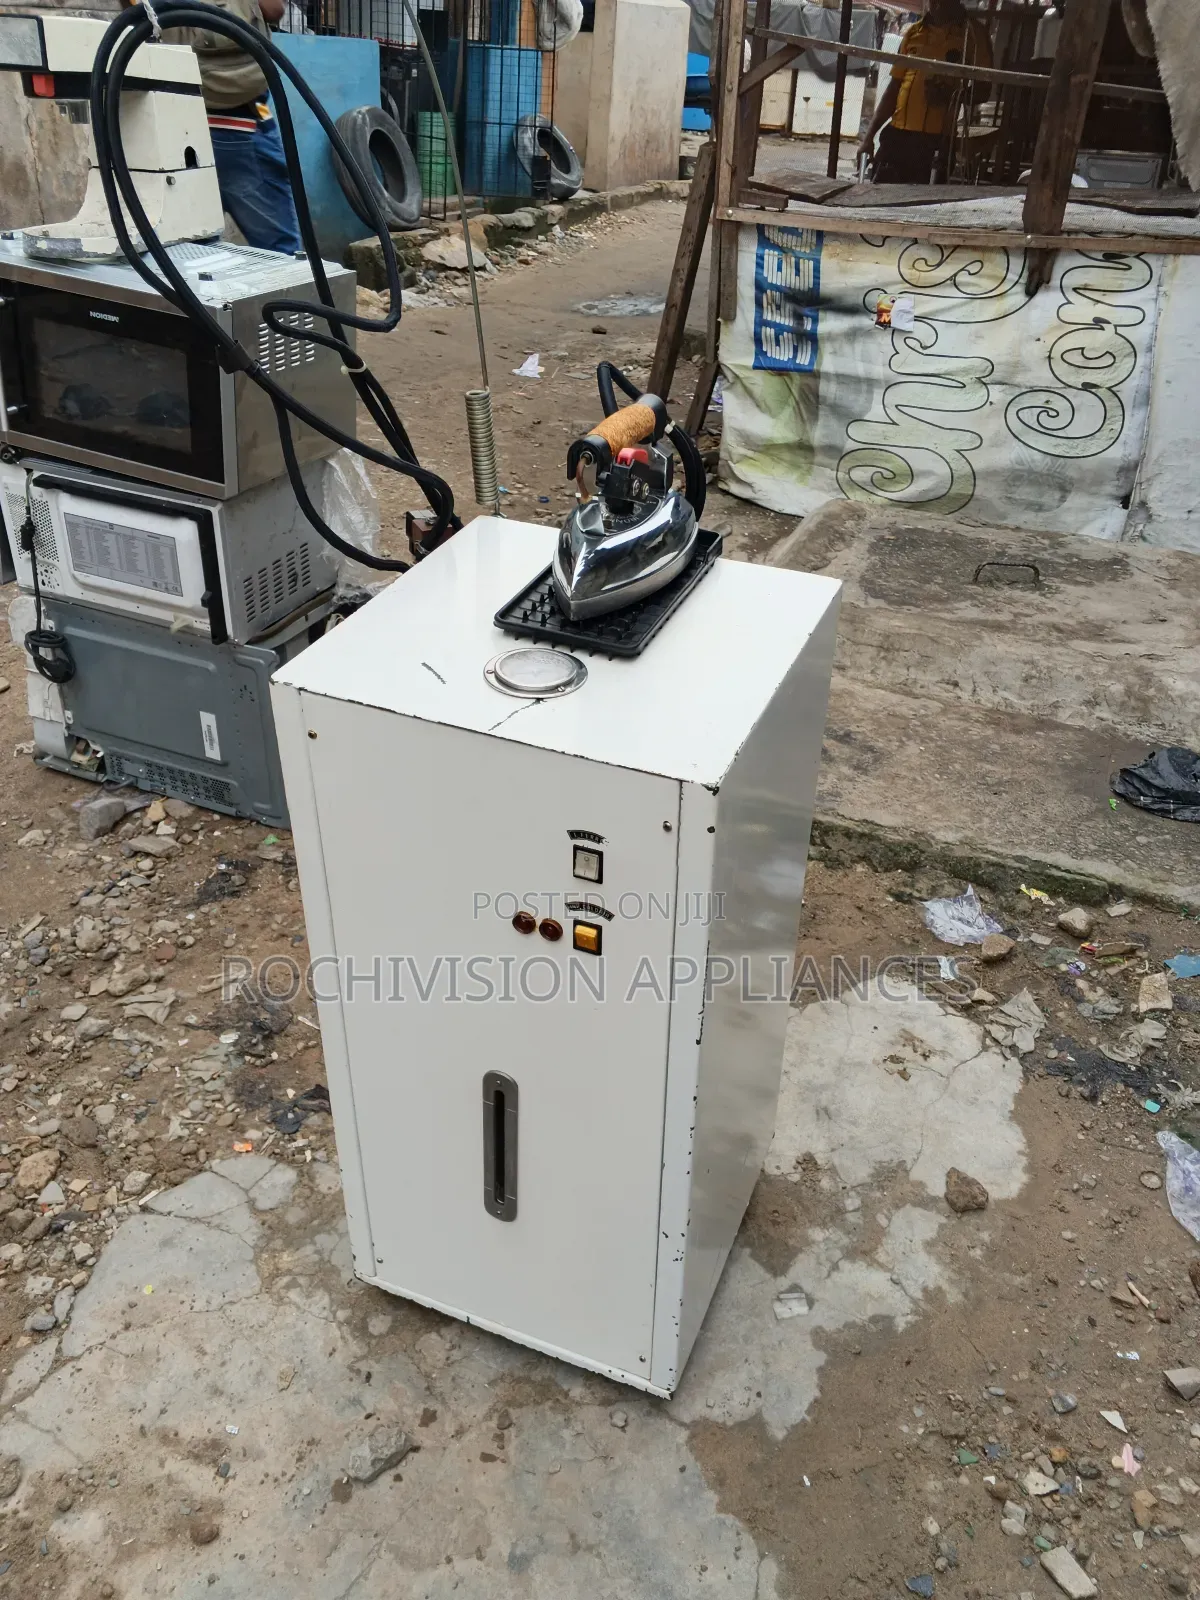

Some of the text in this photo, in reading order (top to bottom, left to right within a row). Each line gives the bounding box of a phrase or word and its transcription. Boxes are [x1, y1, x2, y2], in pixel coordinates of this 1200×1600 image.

[89, 310, 120, 323] MEDION
[835, 234, 1029, 516] Chris
[1005, 234, 1154, 458] Con
